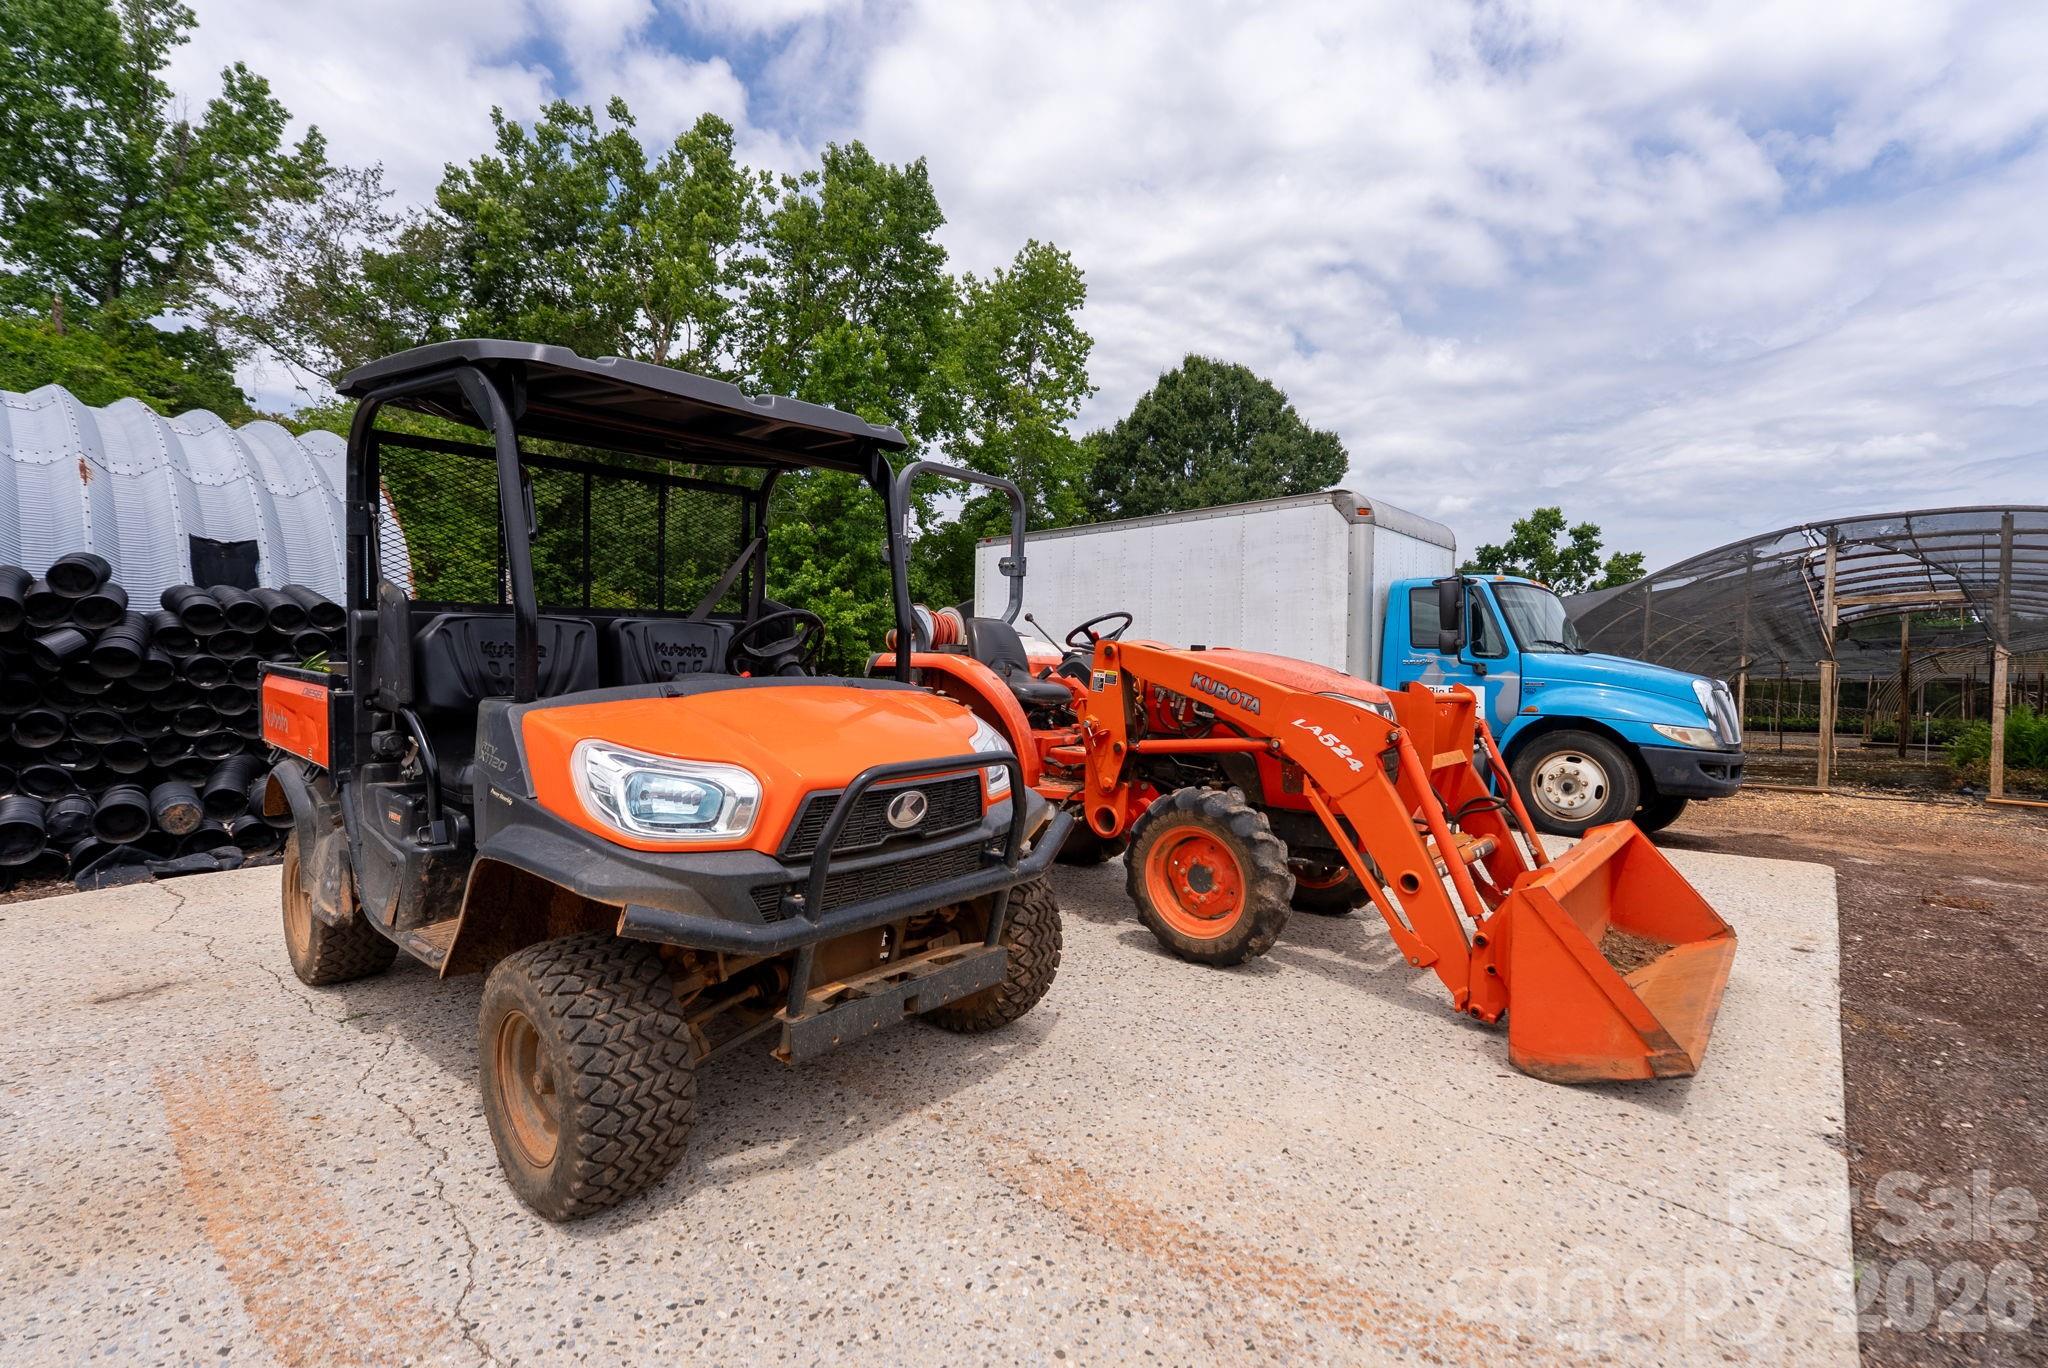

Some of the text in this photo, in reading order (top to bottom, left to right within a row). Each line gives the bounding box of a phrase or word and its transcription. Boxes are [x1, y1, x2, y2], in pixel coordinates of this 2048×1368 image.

[480, 640, 548, 659] Kuba
[655, 642, 708, 659] Kubota
[302, 687, 324, 699] DIESEL
[1190, 671, 1262, 716] KUBOTA
[1291, 718, 1364, 773] LA524
